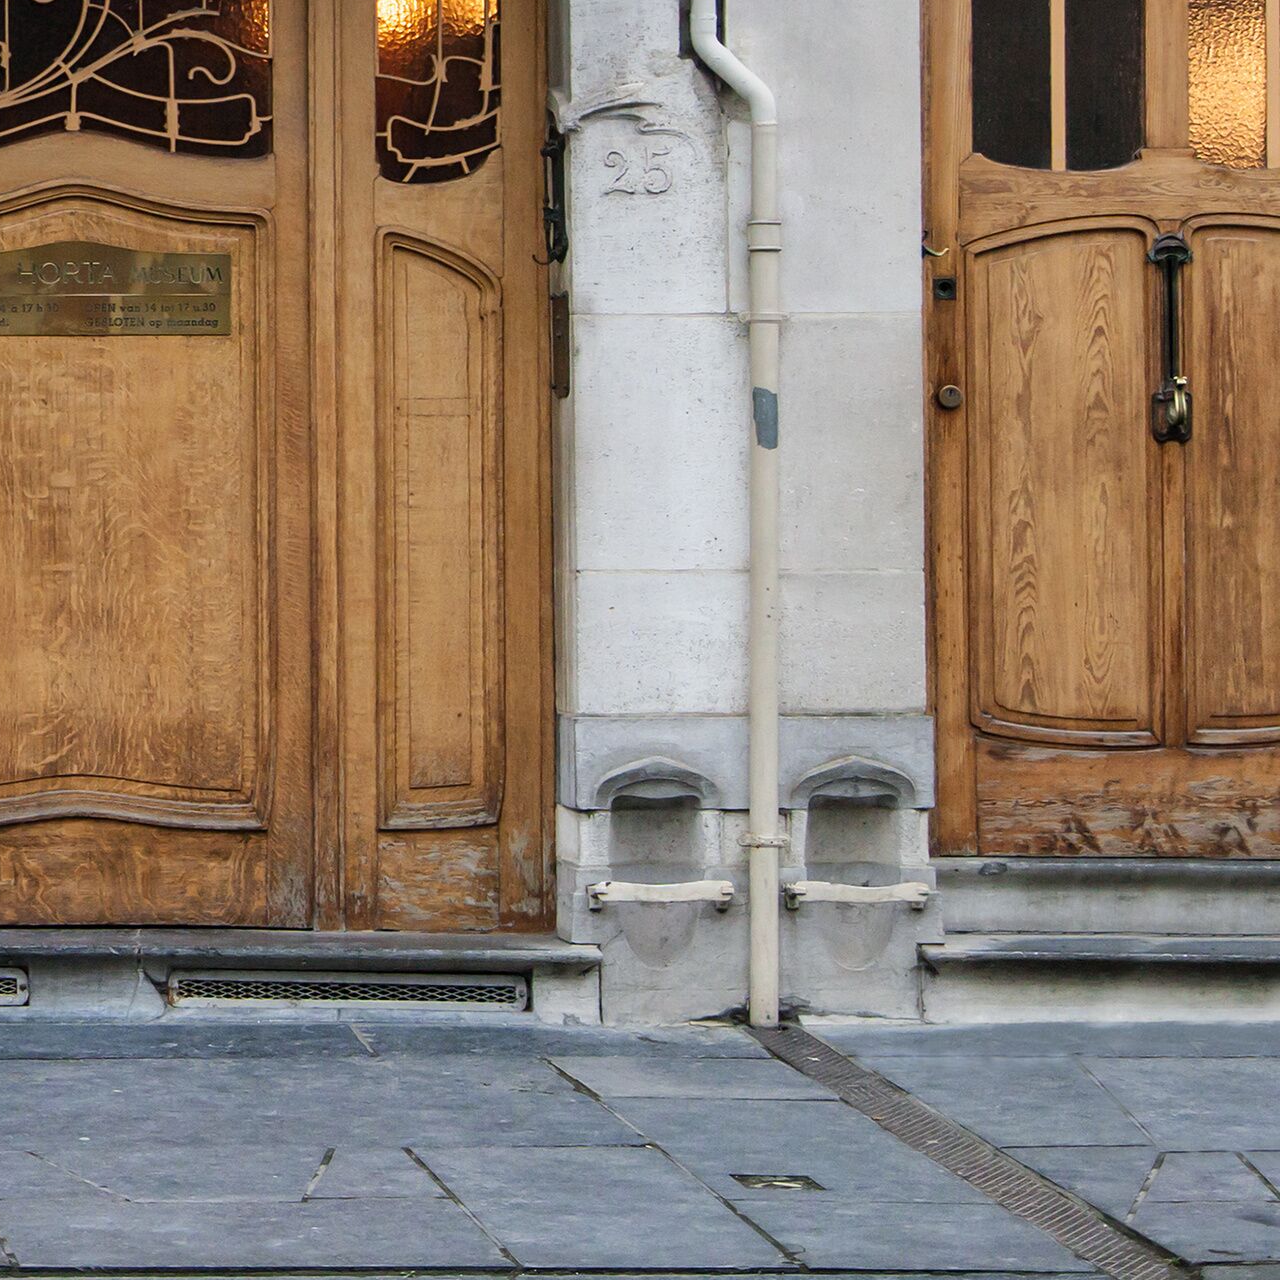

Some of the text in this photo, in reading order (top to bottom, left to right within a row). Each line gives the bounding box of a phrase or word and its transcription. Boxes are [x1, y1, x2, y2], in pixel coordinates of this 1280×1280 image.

[601, 146, 673, 196] 25
[16, 261, 118, 285] HORTA
[130, 266, 224, 285] MUSEUM
[22, 303, 33, 313] 17
[119, 305, 141, 313] van
[149, 319, 163, 328] op
[166, 316, 219, 328] maandag
